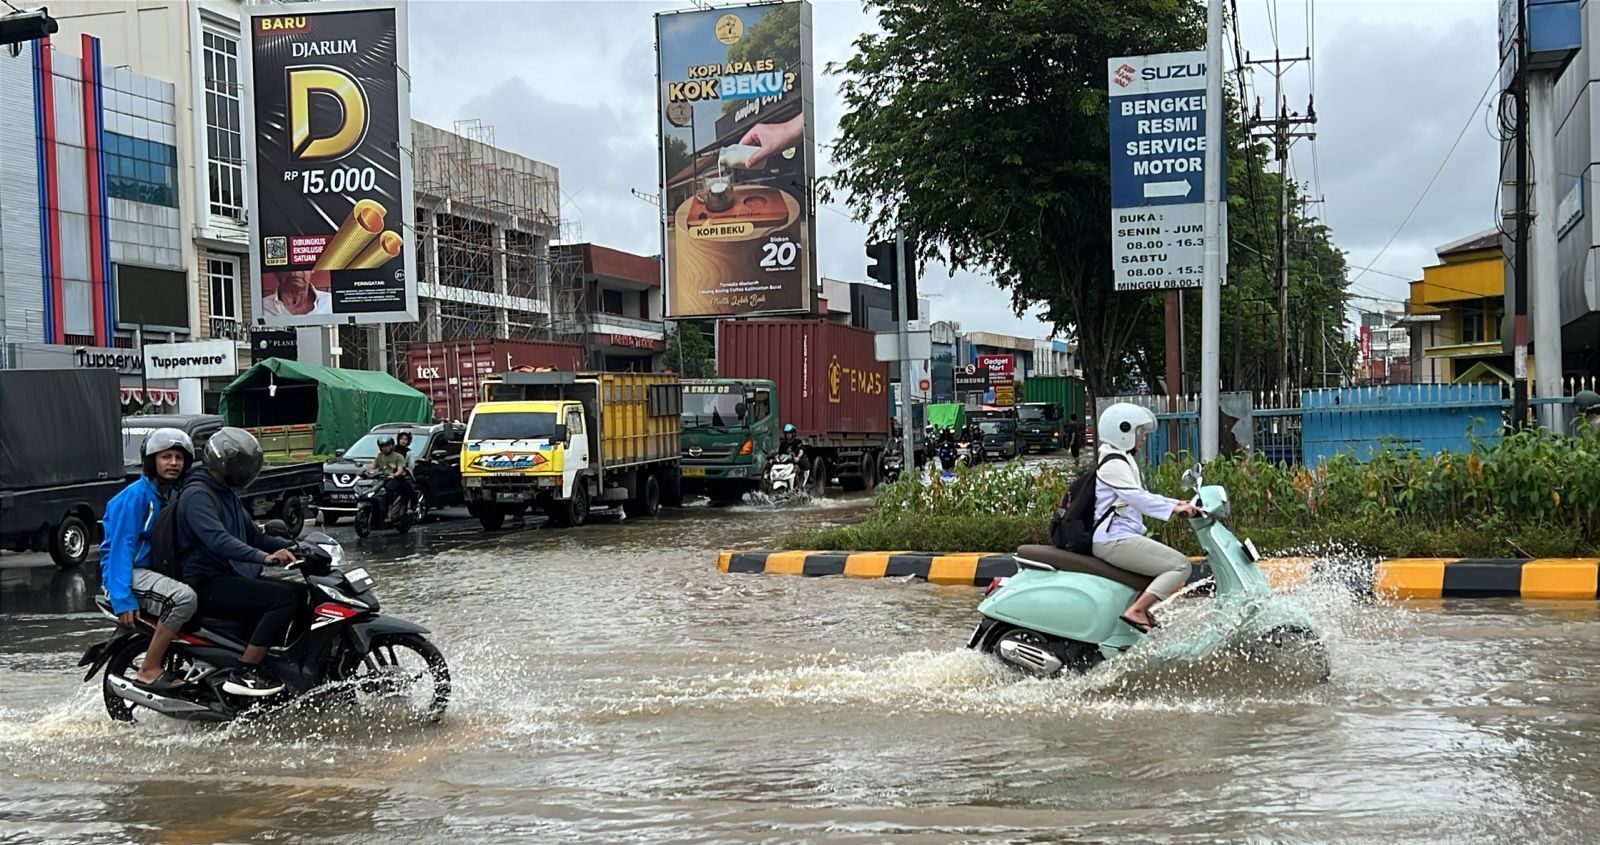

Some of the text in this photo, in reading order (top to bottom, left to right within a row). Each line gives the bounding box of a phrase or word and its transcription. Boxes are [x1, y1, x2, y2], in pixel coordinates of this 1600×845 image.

[261, 16, 306, 30] BARU
[292, 39, 357, 57] DJARUM
[688, 59, 774, 78] KOPI APA ES
[669, 79, 718, 101] KOK
[289, 68, 367, 159] D
[1138, 117, 1197, 134] RESMI
[1126, 137, 1206, 156] SERVICE
[1134, 158, 1202, 176] MOTOR
[284, 167, 376, 194] RP 15.000
[1120, 214, 1156, 223] BUKA
[697, 226, 745, 236] KOPI BEKU
[1118, 227, 1160, 237] SENIN
[1173, 225, 1203, 234] JUM
[293, 238, 326, 246] DIBUNGKUS
[1127, 241, 1163, 250] 08.00
[1176, 238, 1204, 247] 16.3
[293, 246, 324, 254] EKSKLUSIF
[1121, 254, 1167, 263] SABTU
[1127, 268, 1164, 277] 08.00
[1177, 266, 1204, 275] 15.3
[1118, 281, 1160, 290] MINGGU
[77, 348, 144, 368] Tupperw
[984, 358, 1008, 366] Gadget
[417, 365, 440, 379] tex
